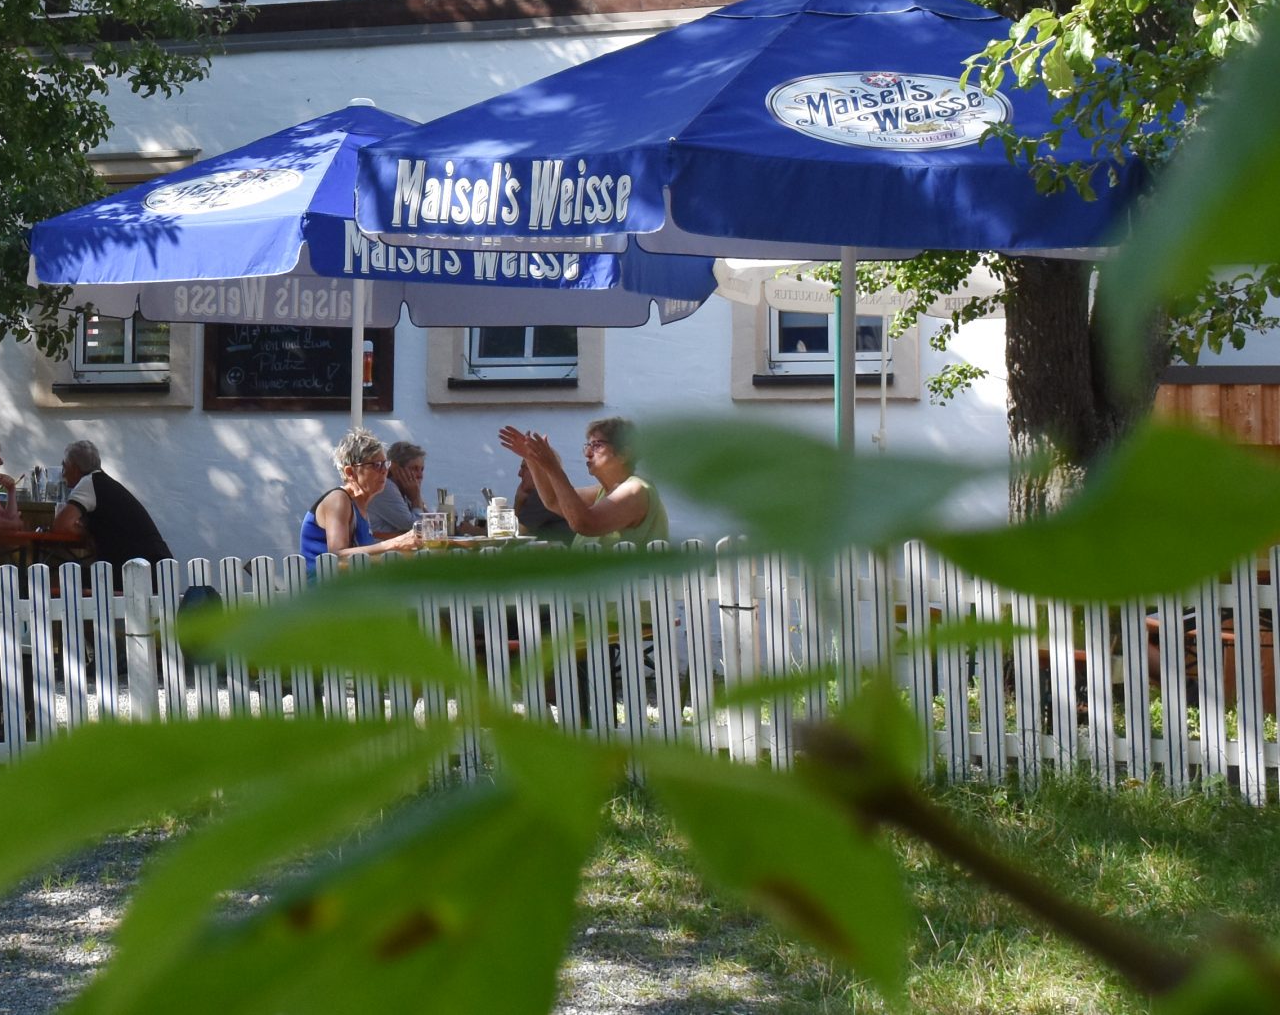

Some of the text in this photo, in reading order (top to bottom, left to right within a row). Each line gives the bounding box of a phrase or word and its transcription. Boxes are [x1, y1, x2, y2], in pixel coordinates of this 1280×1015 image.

[795, 79, 935, 126] Maisel's
[858, 91, 984, 132] Weisse
[392, 159, 632, 230] Maisel's Weisse
